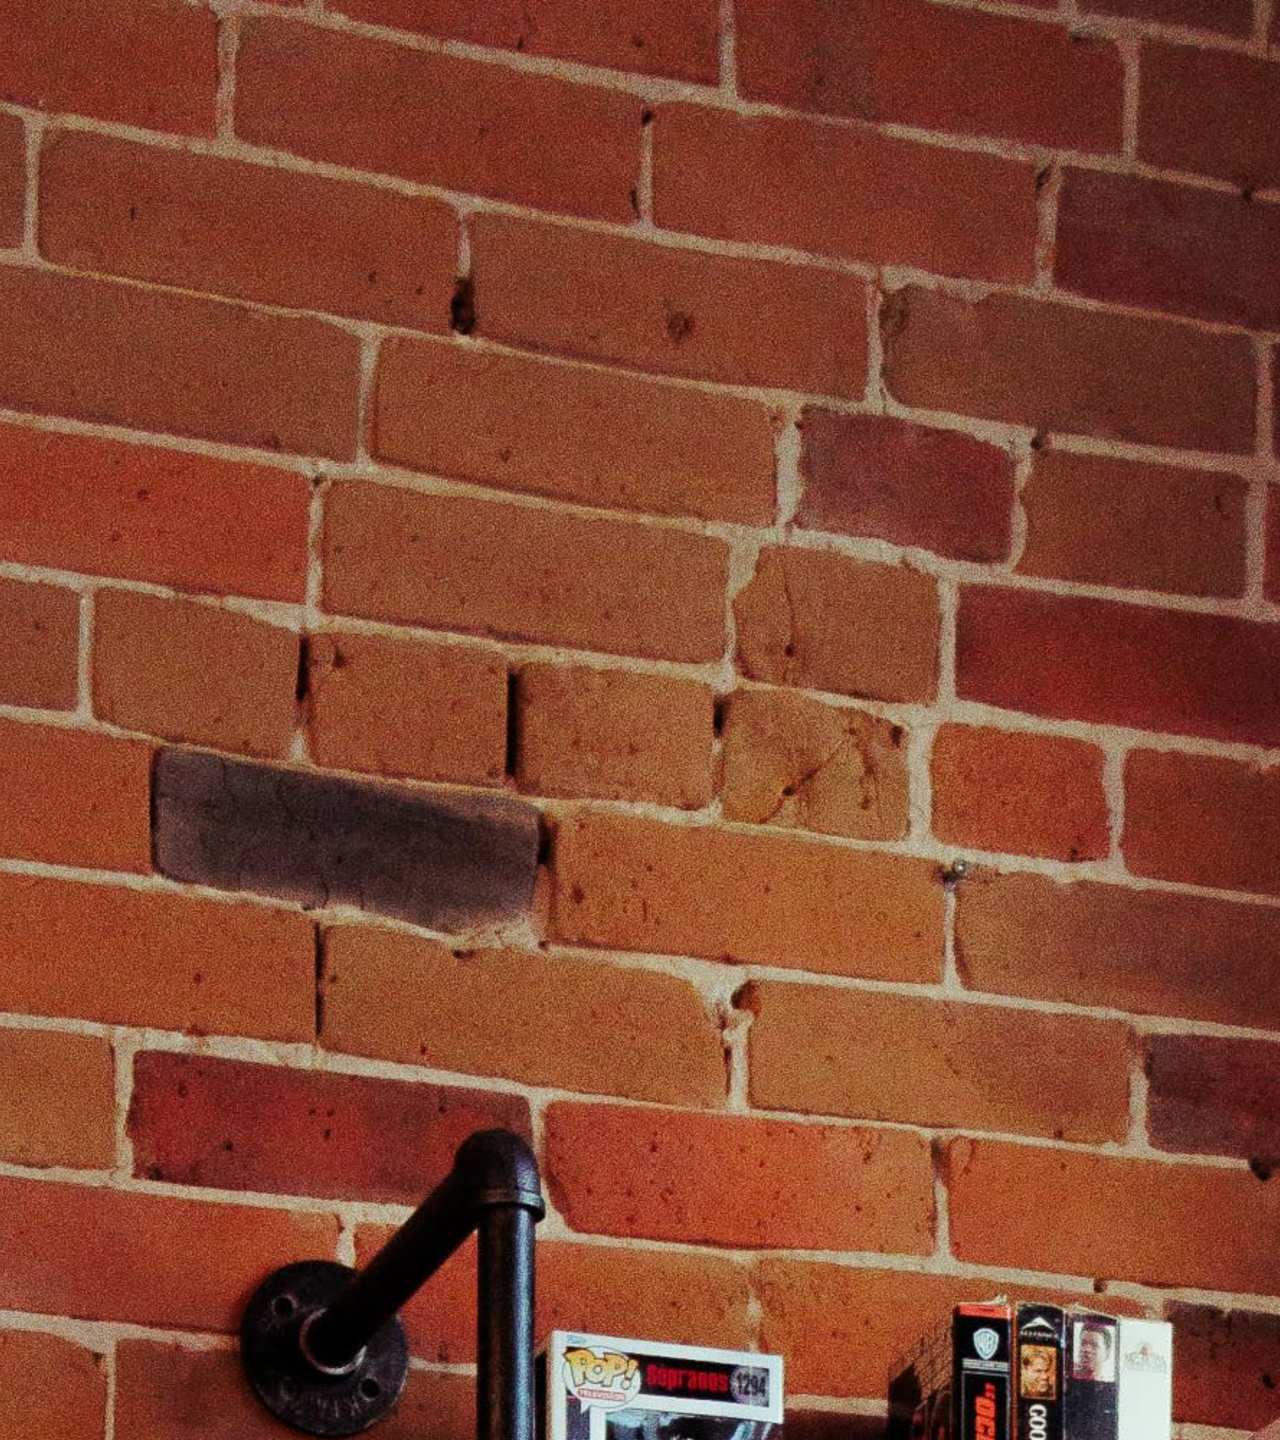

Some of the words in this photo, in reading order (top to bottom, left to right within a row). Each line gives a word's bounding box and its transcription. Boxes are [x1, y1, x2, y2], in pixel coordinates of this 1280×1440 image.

[562, 1349, 638, 1388] POP!
[645, 1364, 730, 1392] Sopranos
[736, 1370, 766, 1396] 1294
